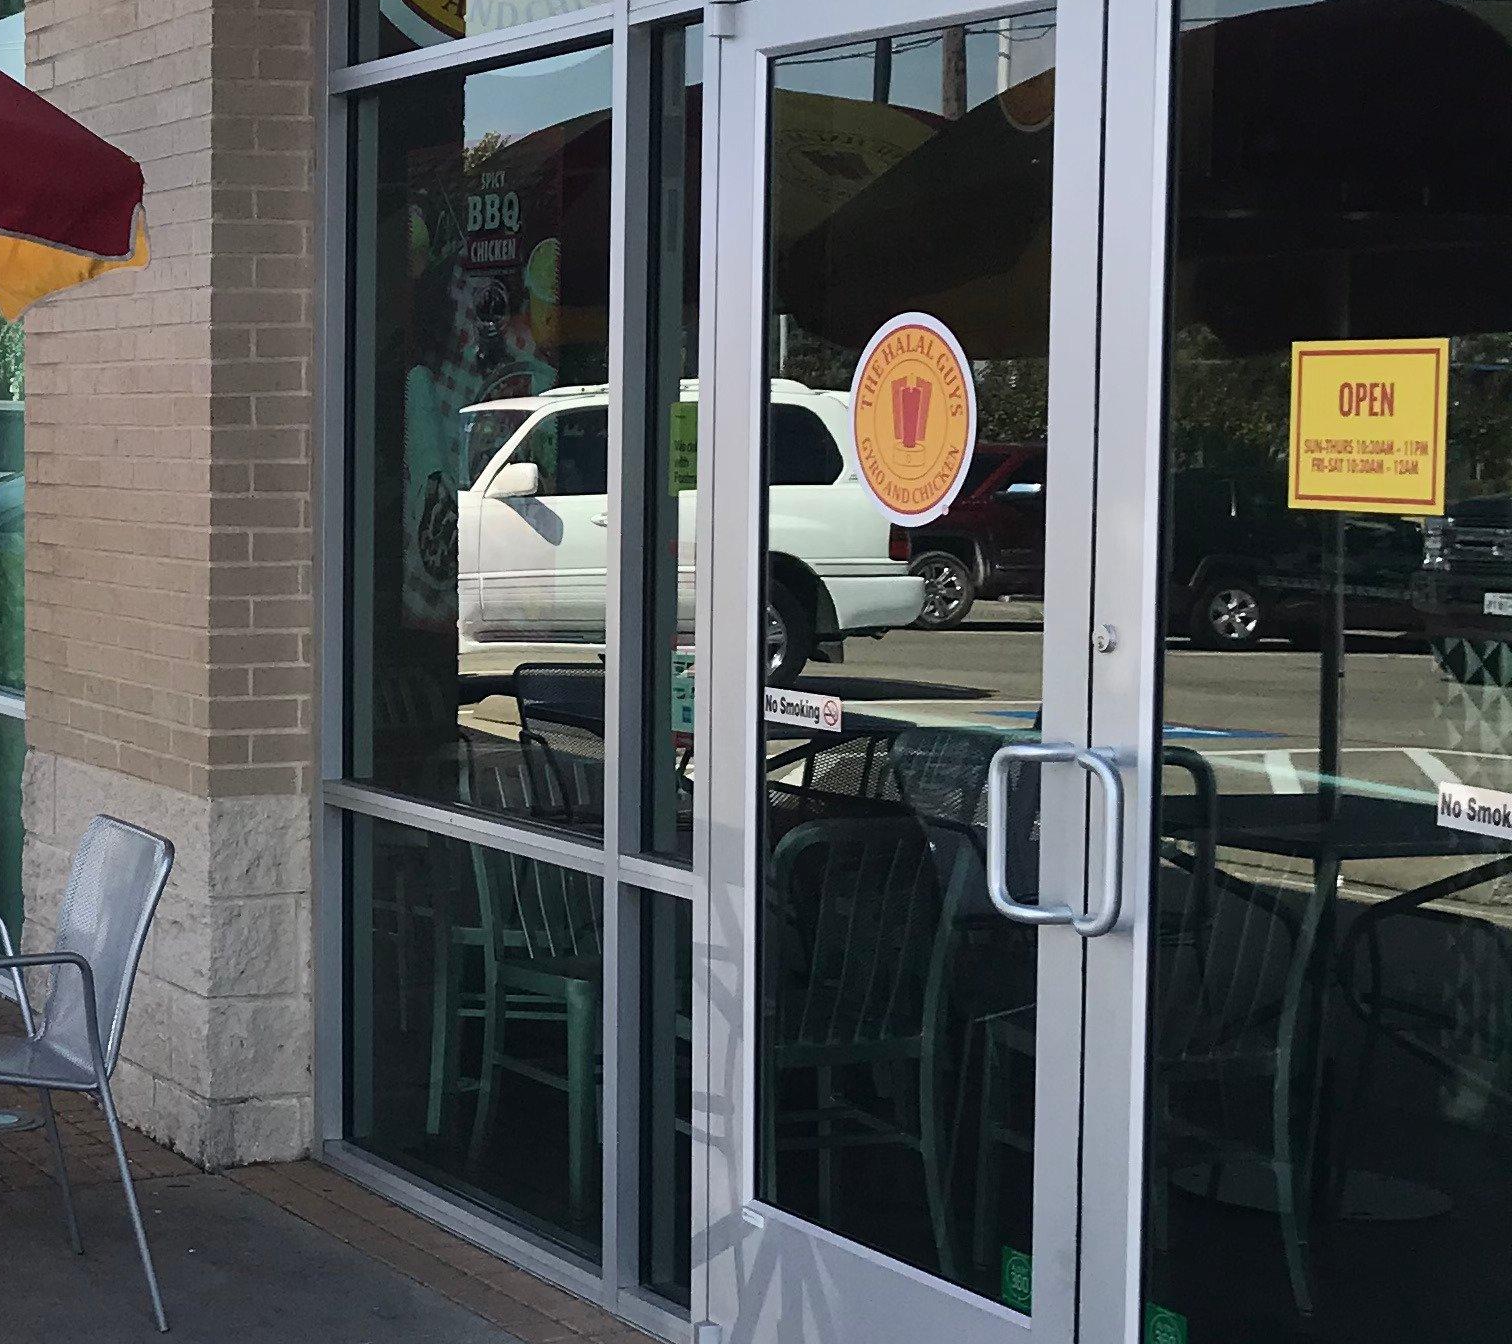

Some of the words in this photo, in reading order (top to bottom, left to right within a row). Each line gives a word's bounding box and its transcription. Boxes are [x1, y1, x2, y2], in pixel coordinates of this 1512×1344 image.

[467, 191, 522, 232] BBQ
[470, 238, 516, 263] CHICKEN
[861, 359, 885, 411] THE
[881, 333, 935, 366] HALAL
[933, 353, 965, 418] GUYS
[1338, 381, 1395, 418] OPEN
[861, 436, 886, 485] GYRO
[881, 481, 910, 504] AND
[911, 443, 960, 505] CHICKEN
[765, 694, 778, 714] No
[779, 696, 821, 725] Smoking
[1440, 791, 1463, 819] No
